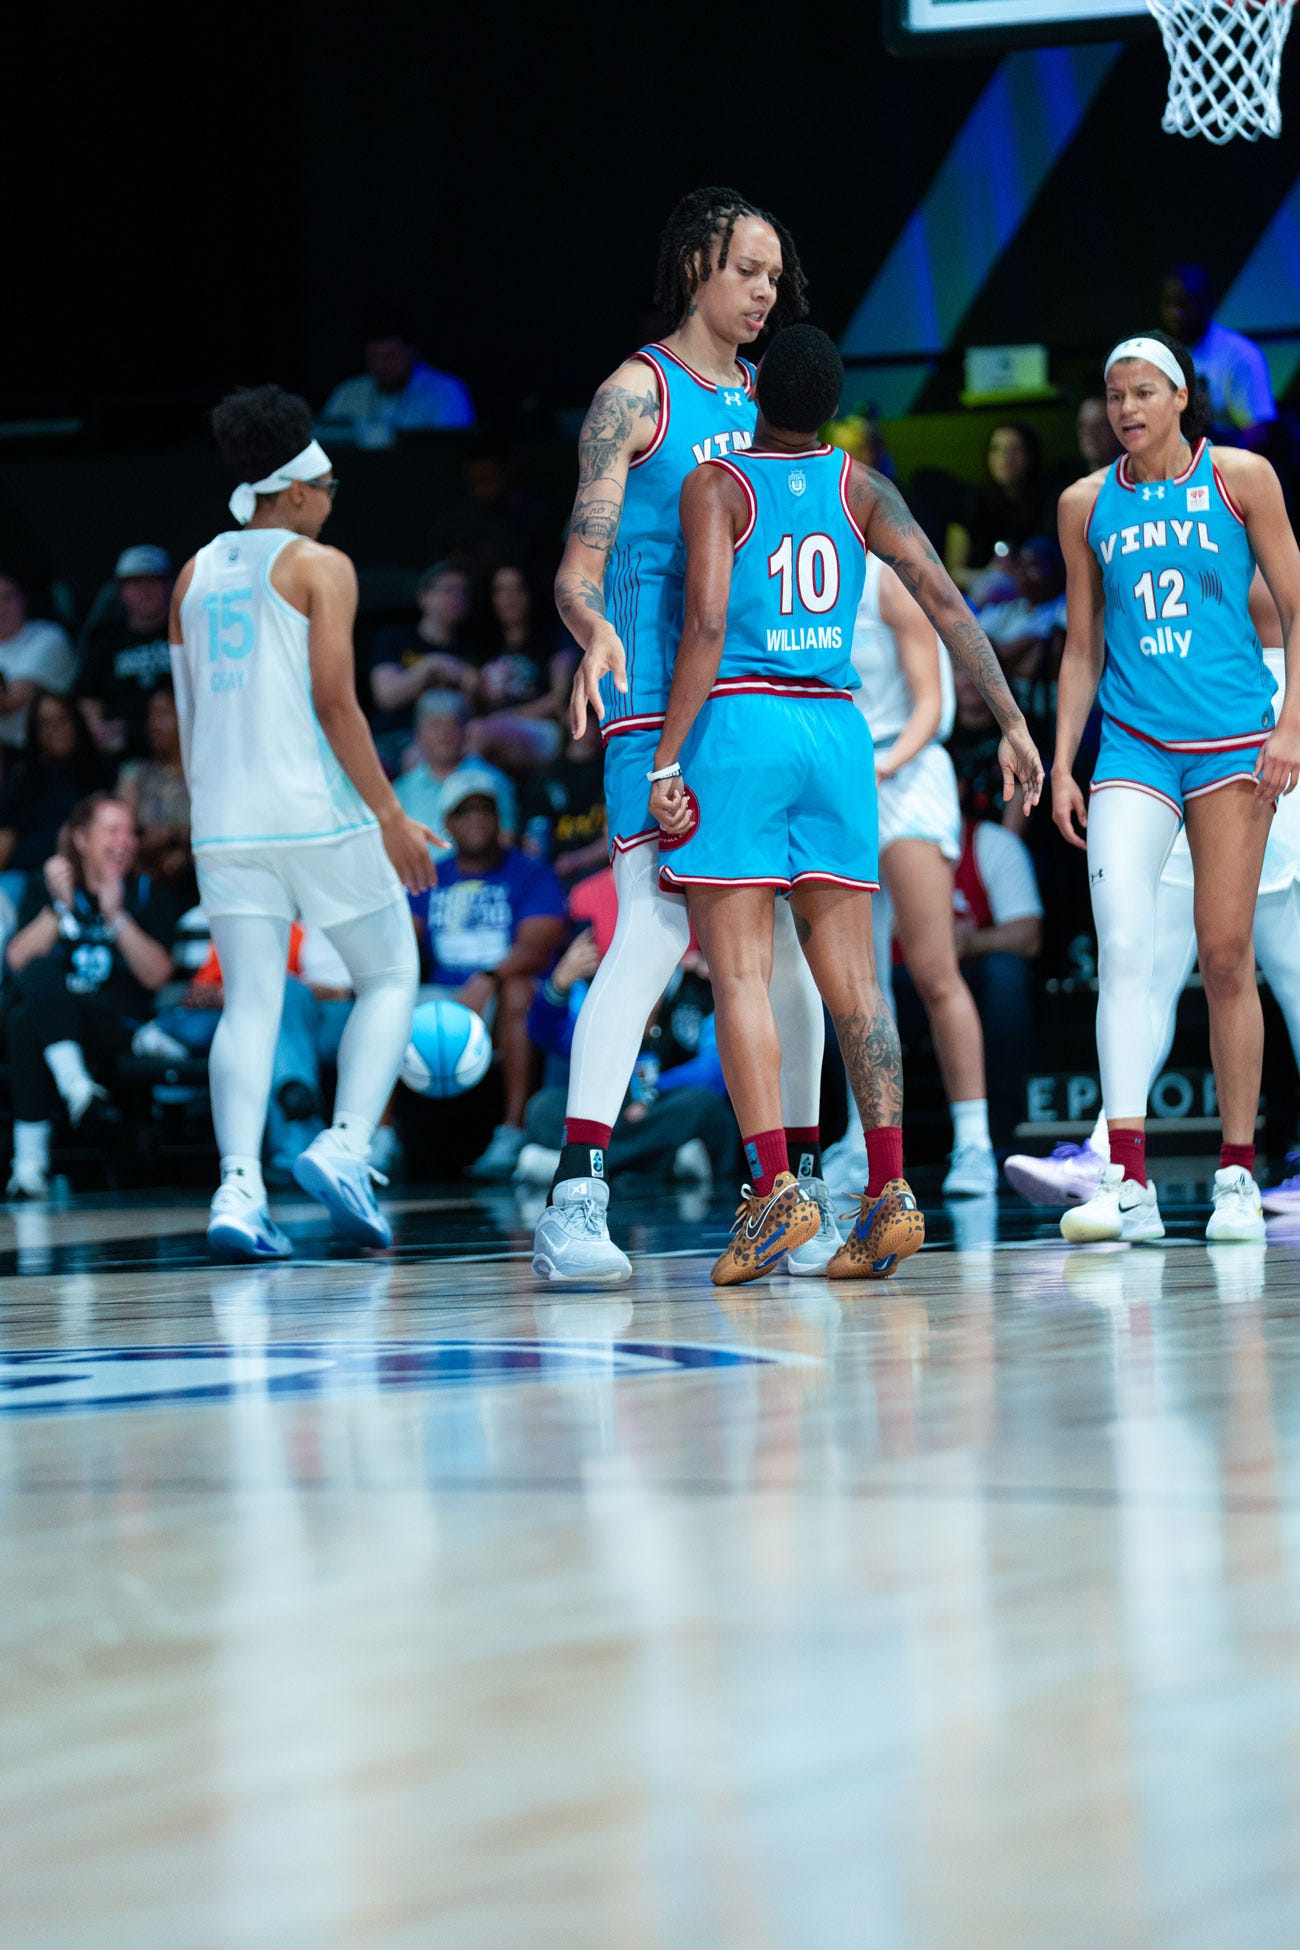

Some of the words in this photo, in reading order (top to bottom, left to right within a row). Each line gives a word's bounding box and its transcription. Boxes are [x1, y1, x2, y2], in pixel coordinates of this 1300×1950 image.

[692, 430, 754, 464] VIN
[1099, 519, 1220, 565] VINYL
[767, 532, 841, 616] 10
[1133, 567, 1190, 621] 12
[202, 587, 255, 661] 15
[766, 626, 843, 652] WILLIAMS
[1139, 625, 1193, 659] ally
